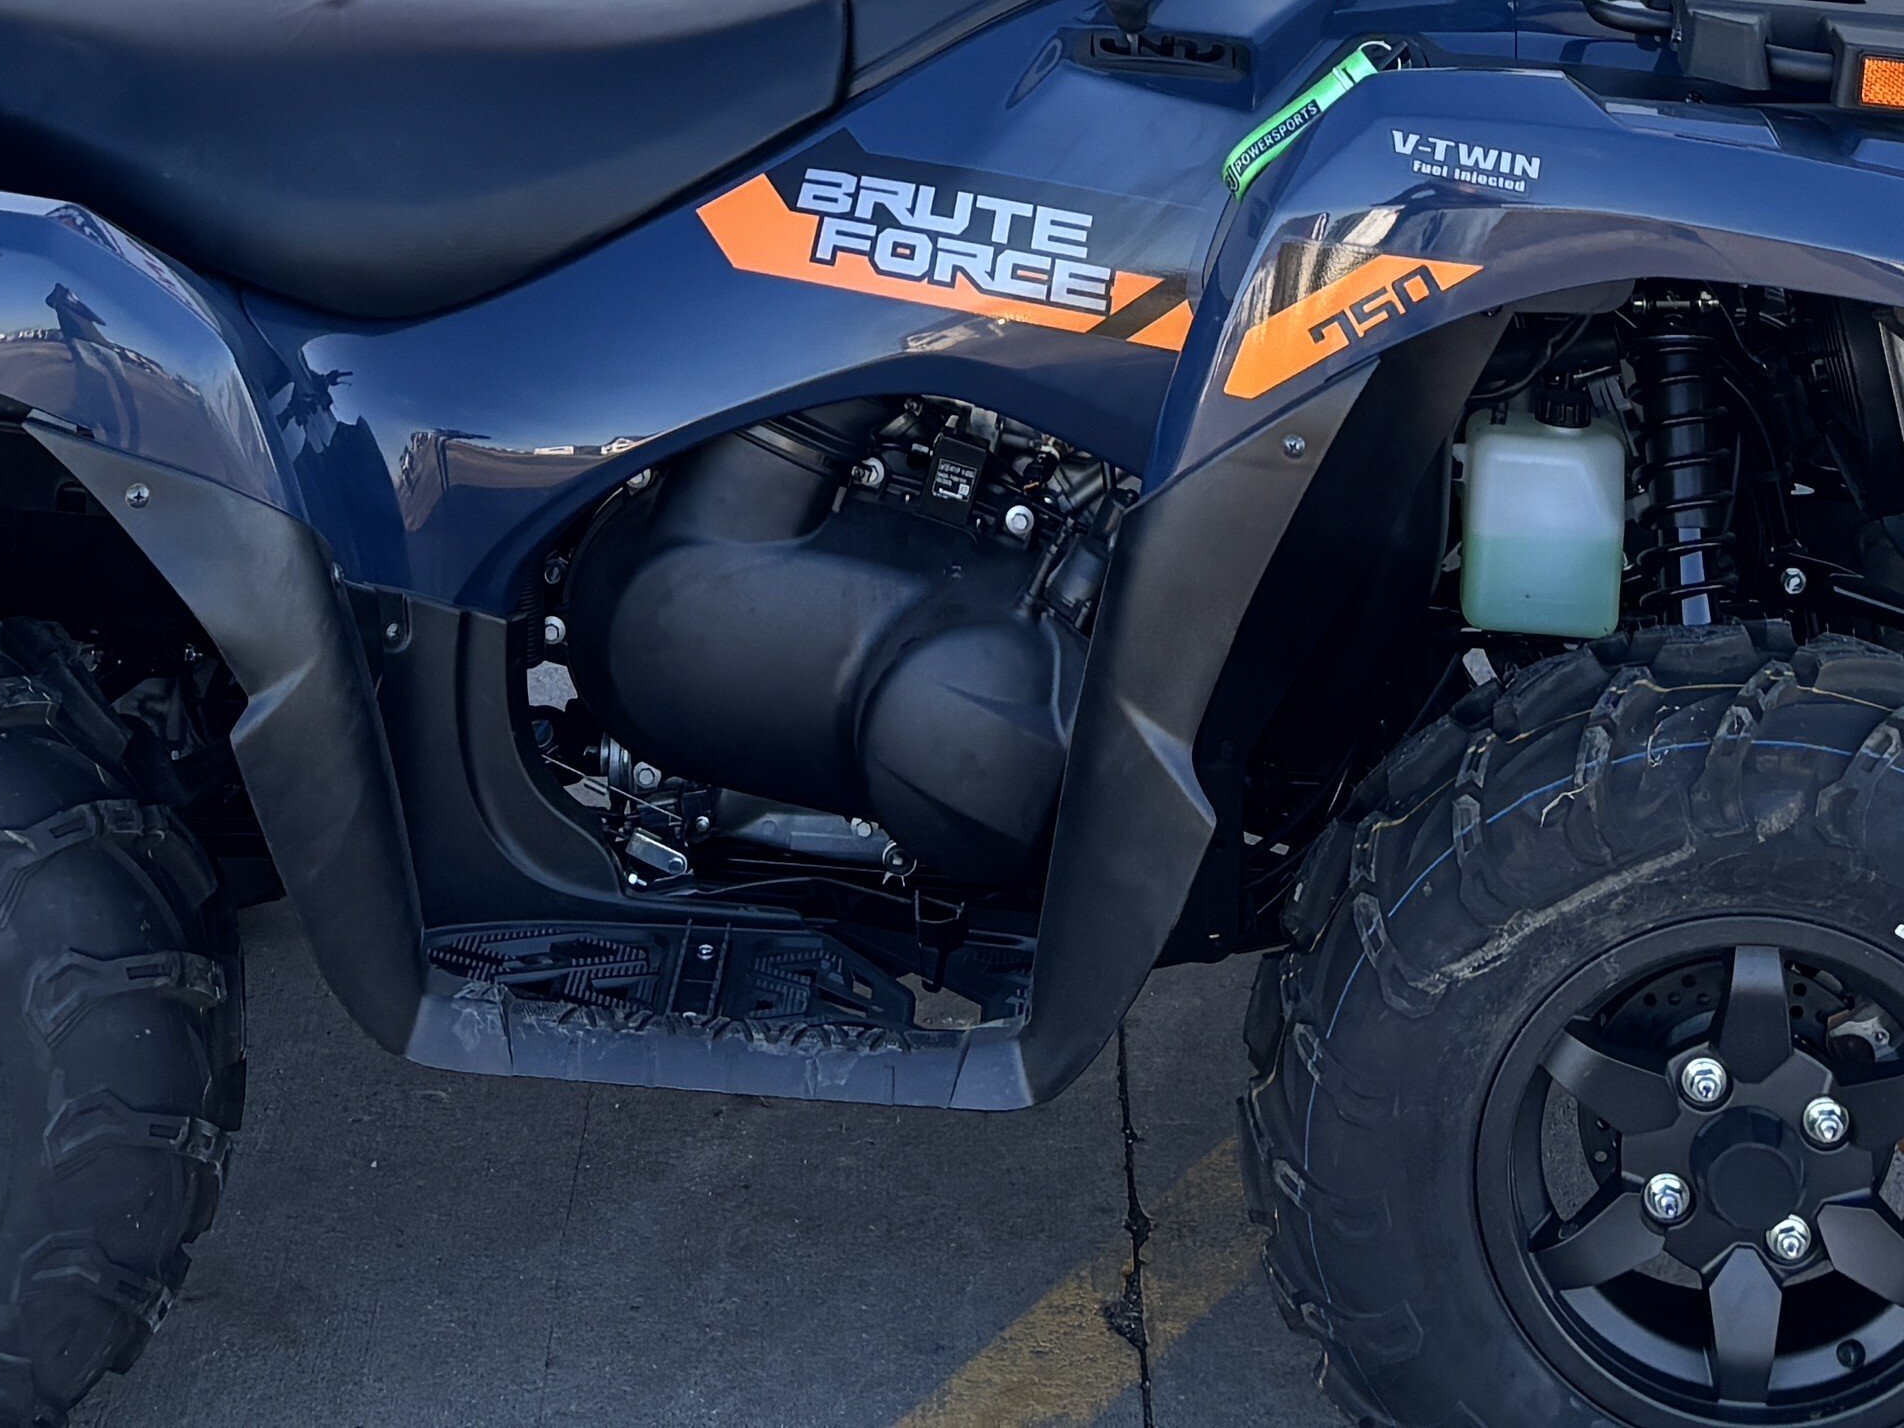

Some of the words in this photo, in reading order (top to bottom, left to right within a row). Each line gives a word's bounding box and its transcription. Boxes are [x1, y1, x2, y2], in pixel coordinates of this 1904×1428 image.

[1234, 102, 1319, 174] POWERSPORTS
[1392, 130, 1541, 180] V-TWIN
[797, 168, 1093, 259] BRUTE
[1412, 160, 1448, 177] Fuel
[1454, 167, 1526, 193] Injected
[815, 217, 1111, 311] FORCE
[1307, 265, 1442, 346] 750
